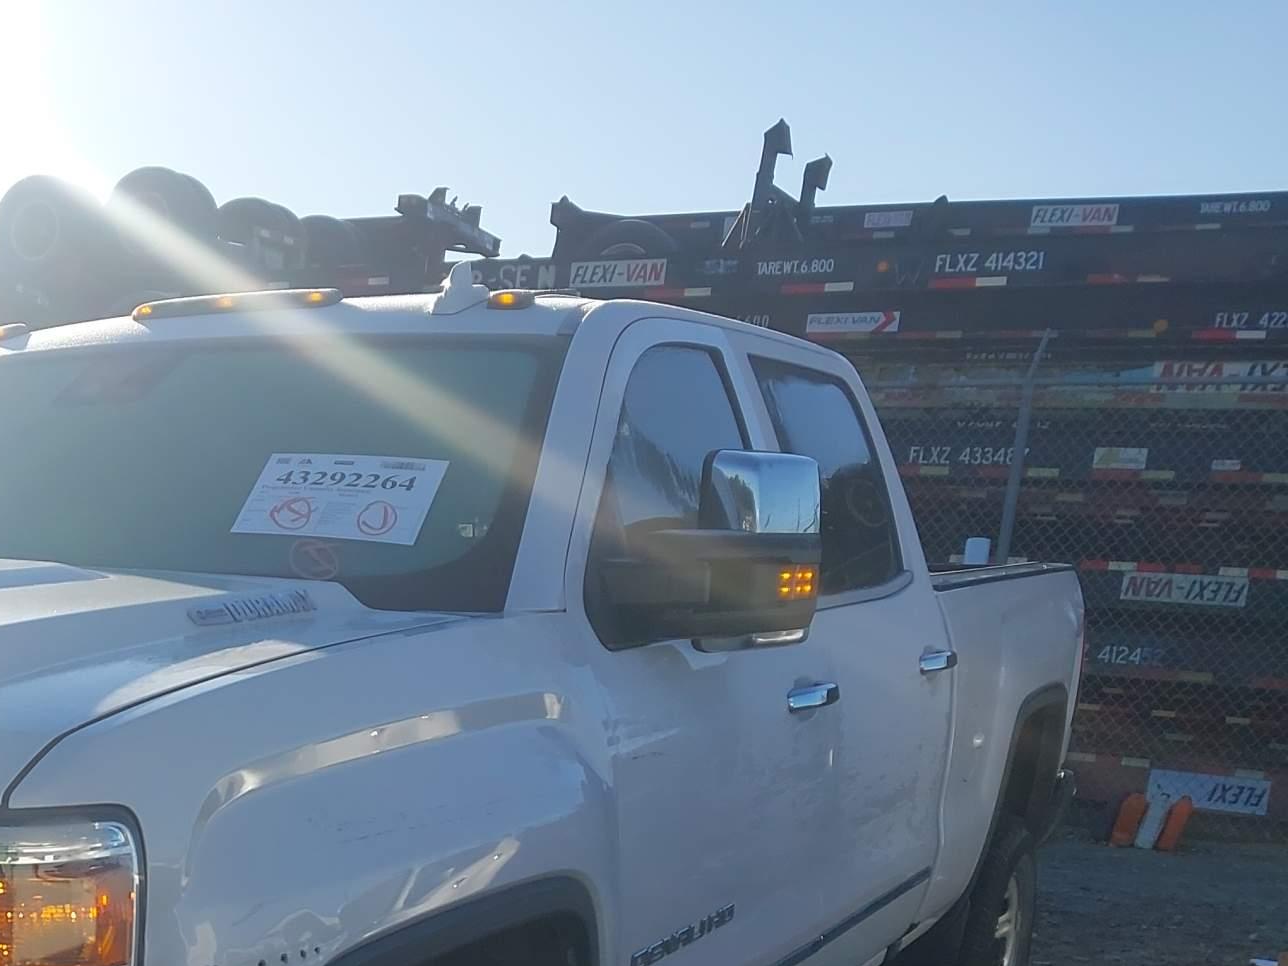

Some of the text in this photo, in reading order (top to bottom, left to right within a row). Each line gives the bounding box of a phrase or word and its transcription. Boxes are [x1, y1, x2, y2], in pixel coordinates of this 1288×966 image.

[1032, 206, 1116, 224] FLEXI-VAN
[935, 251, 1045, 272] FLXZ 414321
[572, 264, 664, 285] FLEXI-VAN
[1215, 311, 1288, 329] FLXZ 422
[909, 447, 951, 464] FLXZ
[276, 470, 416, 491] 43292264
